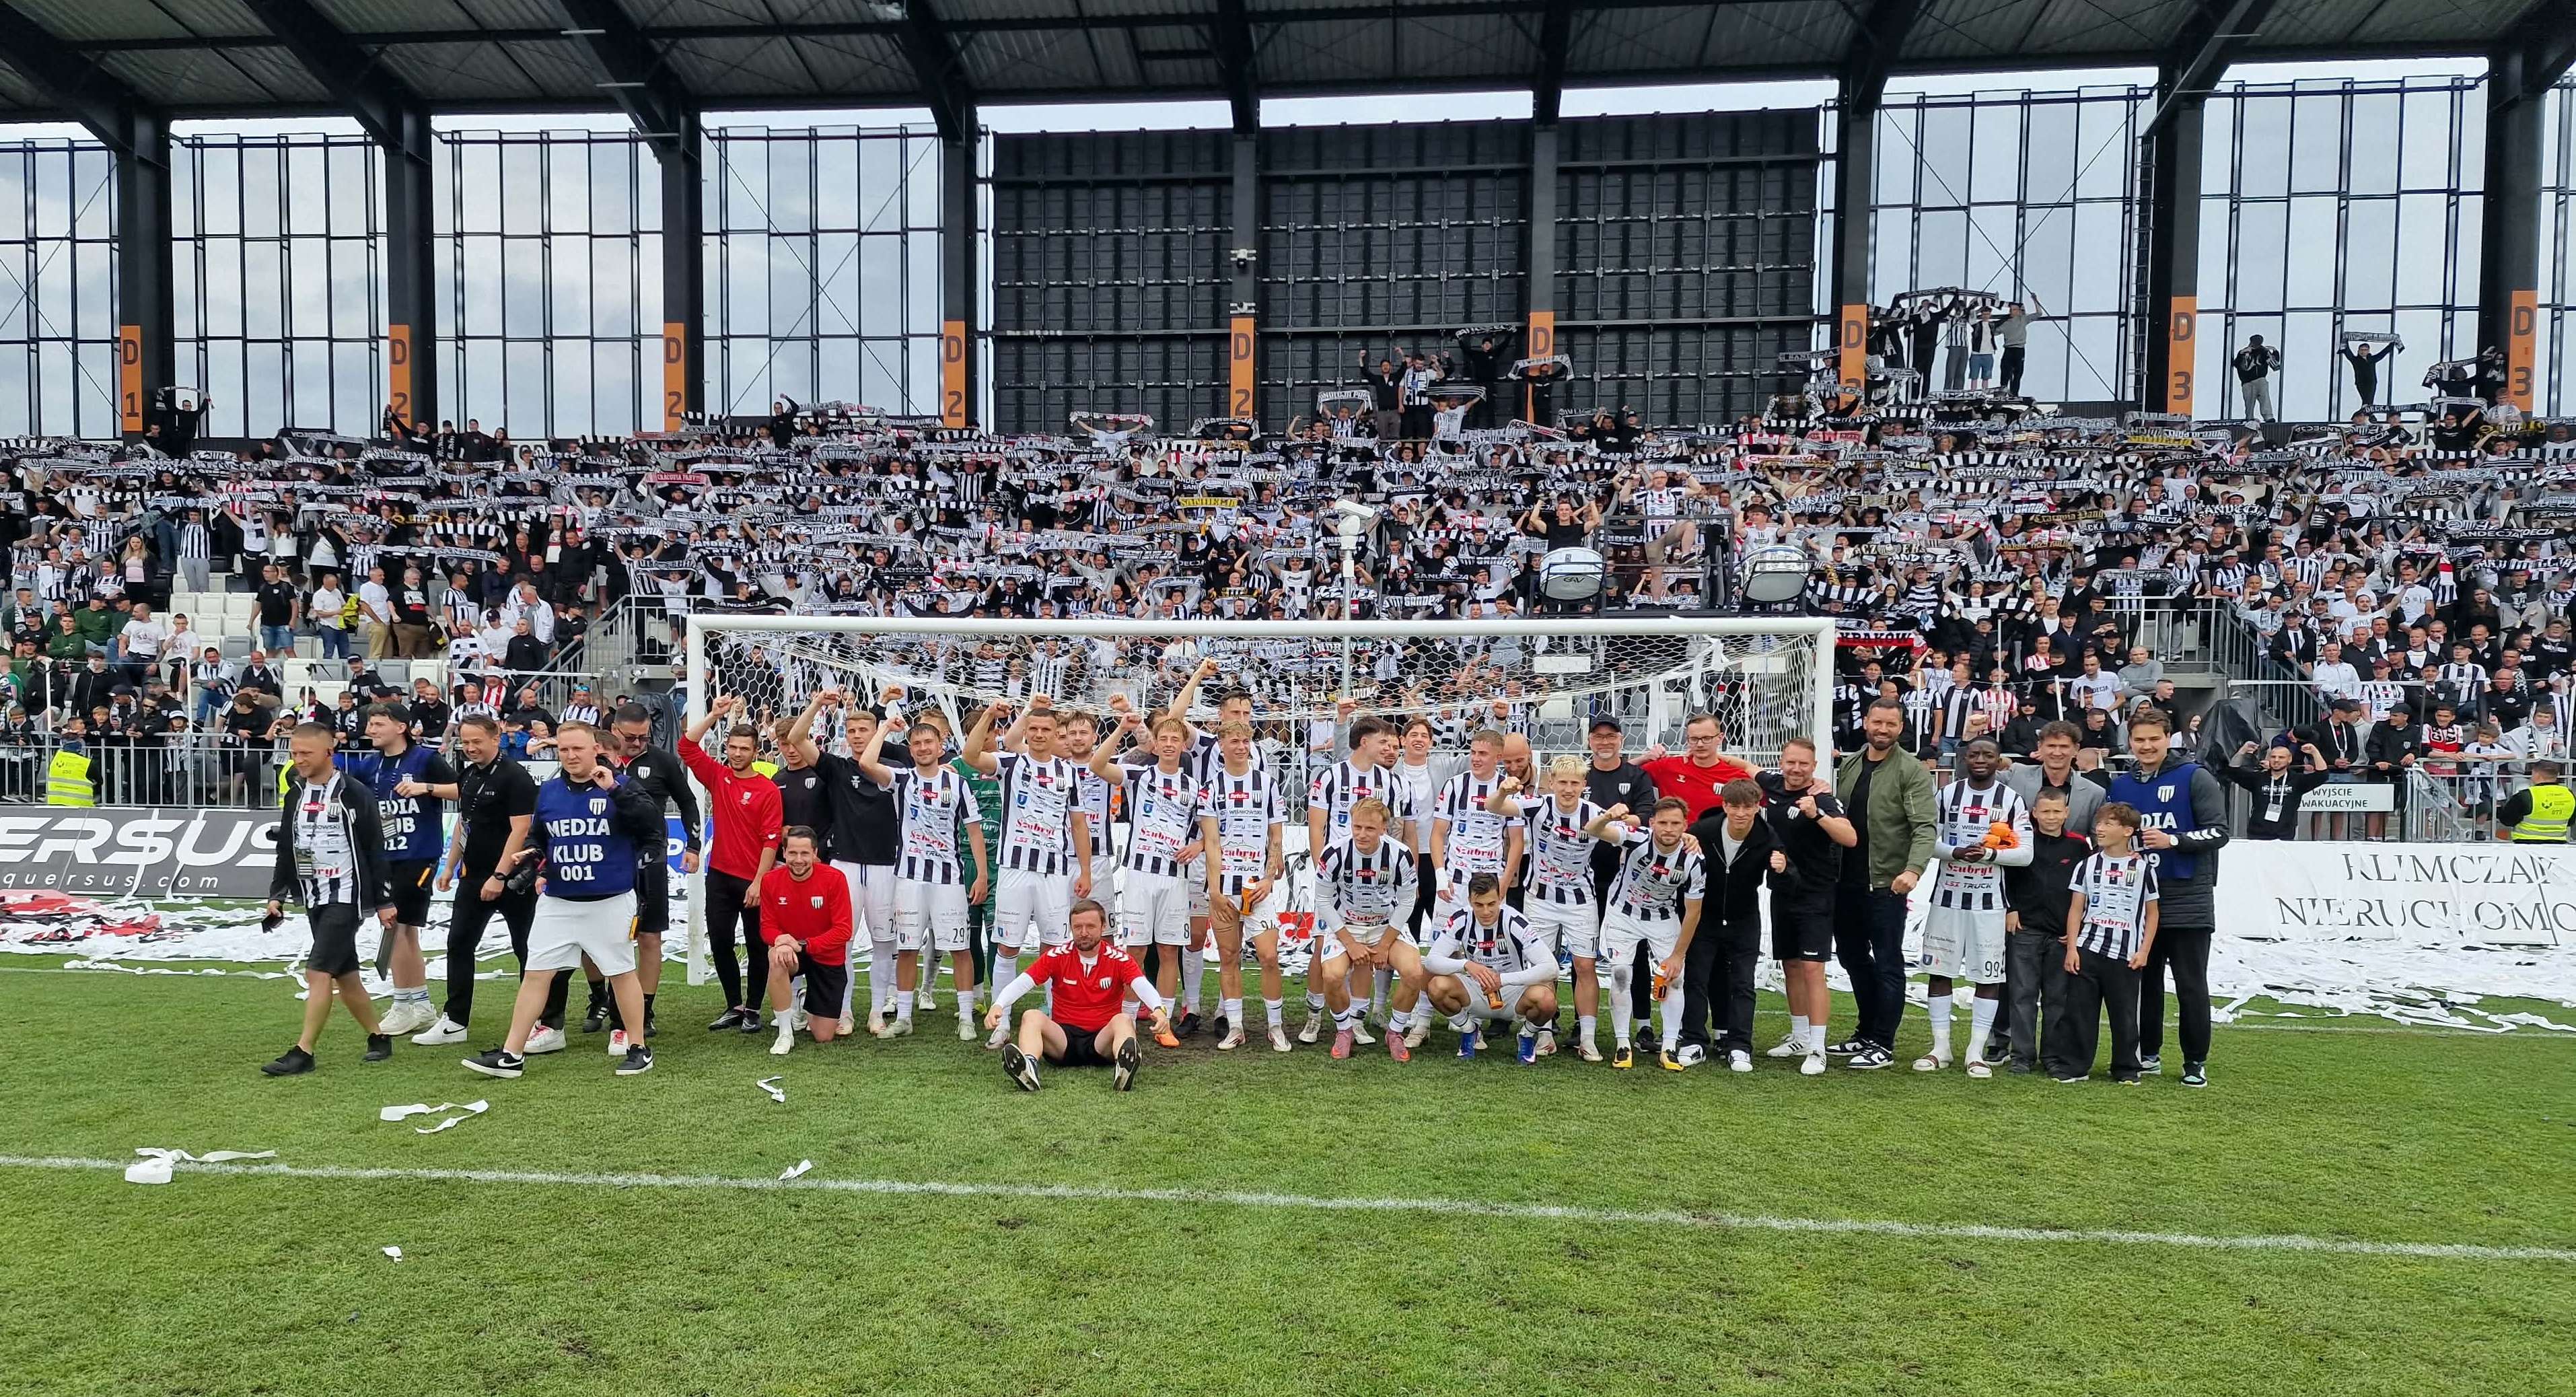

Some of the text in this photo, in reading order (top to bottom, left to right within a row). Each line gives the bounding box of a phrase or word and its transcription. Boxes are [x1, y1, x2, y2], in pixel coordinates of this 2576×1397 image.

[2173, 312, 2194, 341] D
[2513, 307, 2534, 336] D
[1533, 327, 1550, 355] D
[1845, 320, 1863, 349] D
[122, 339, 139, 365] D
[390, 338, 407, 365] D
[666, 338, 682, 364] D
[945, 337, 962, 363] D
[1234, 333, 1250, 360] D
[2172, 371, 2191, 401] 3
[2513, 367, 2532, 397] 3
[125, 392, 139, 417] 1
[393, 392, 408, 417] 2
[666, 392, 682, 417] 2
[947, 391, 962, 417] 2
[1234, 390, 1250, 416] 2
[2257, 452, 2301, 460] SANDECJA
[2207, 464, 2268, 474] SANDECJA
[1388, 485, 1426, 493] SANDECJA
[2136, 514, 2183, 524] SANDECJA
[713, 599, 767, 607] SANDECJA
[2312, 786, 2353, 797] WYJŚCIE
[378, 797, 421, 816] EDIA
[2300, 799, 2369, 810] WAKUACYJNE
[546, 818, 611, 838] MEDIA
[2140, 811, 2178, 830] DIA
[384, 836, 408, 851] 12
[552, 844, 604, 864] KLUB
[561, 865, 596, 882] 001
[1947, 863, 1994, 877] Szubryt
[953, 927, 965, 943] 29
[1183, 923, 1190, 939] 8
[1984, 960, 2000, 978] 99
